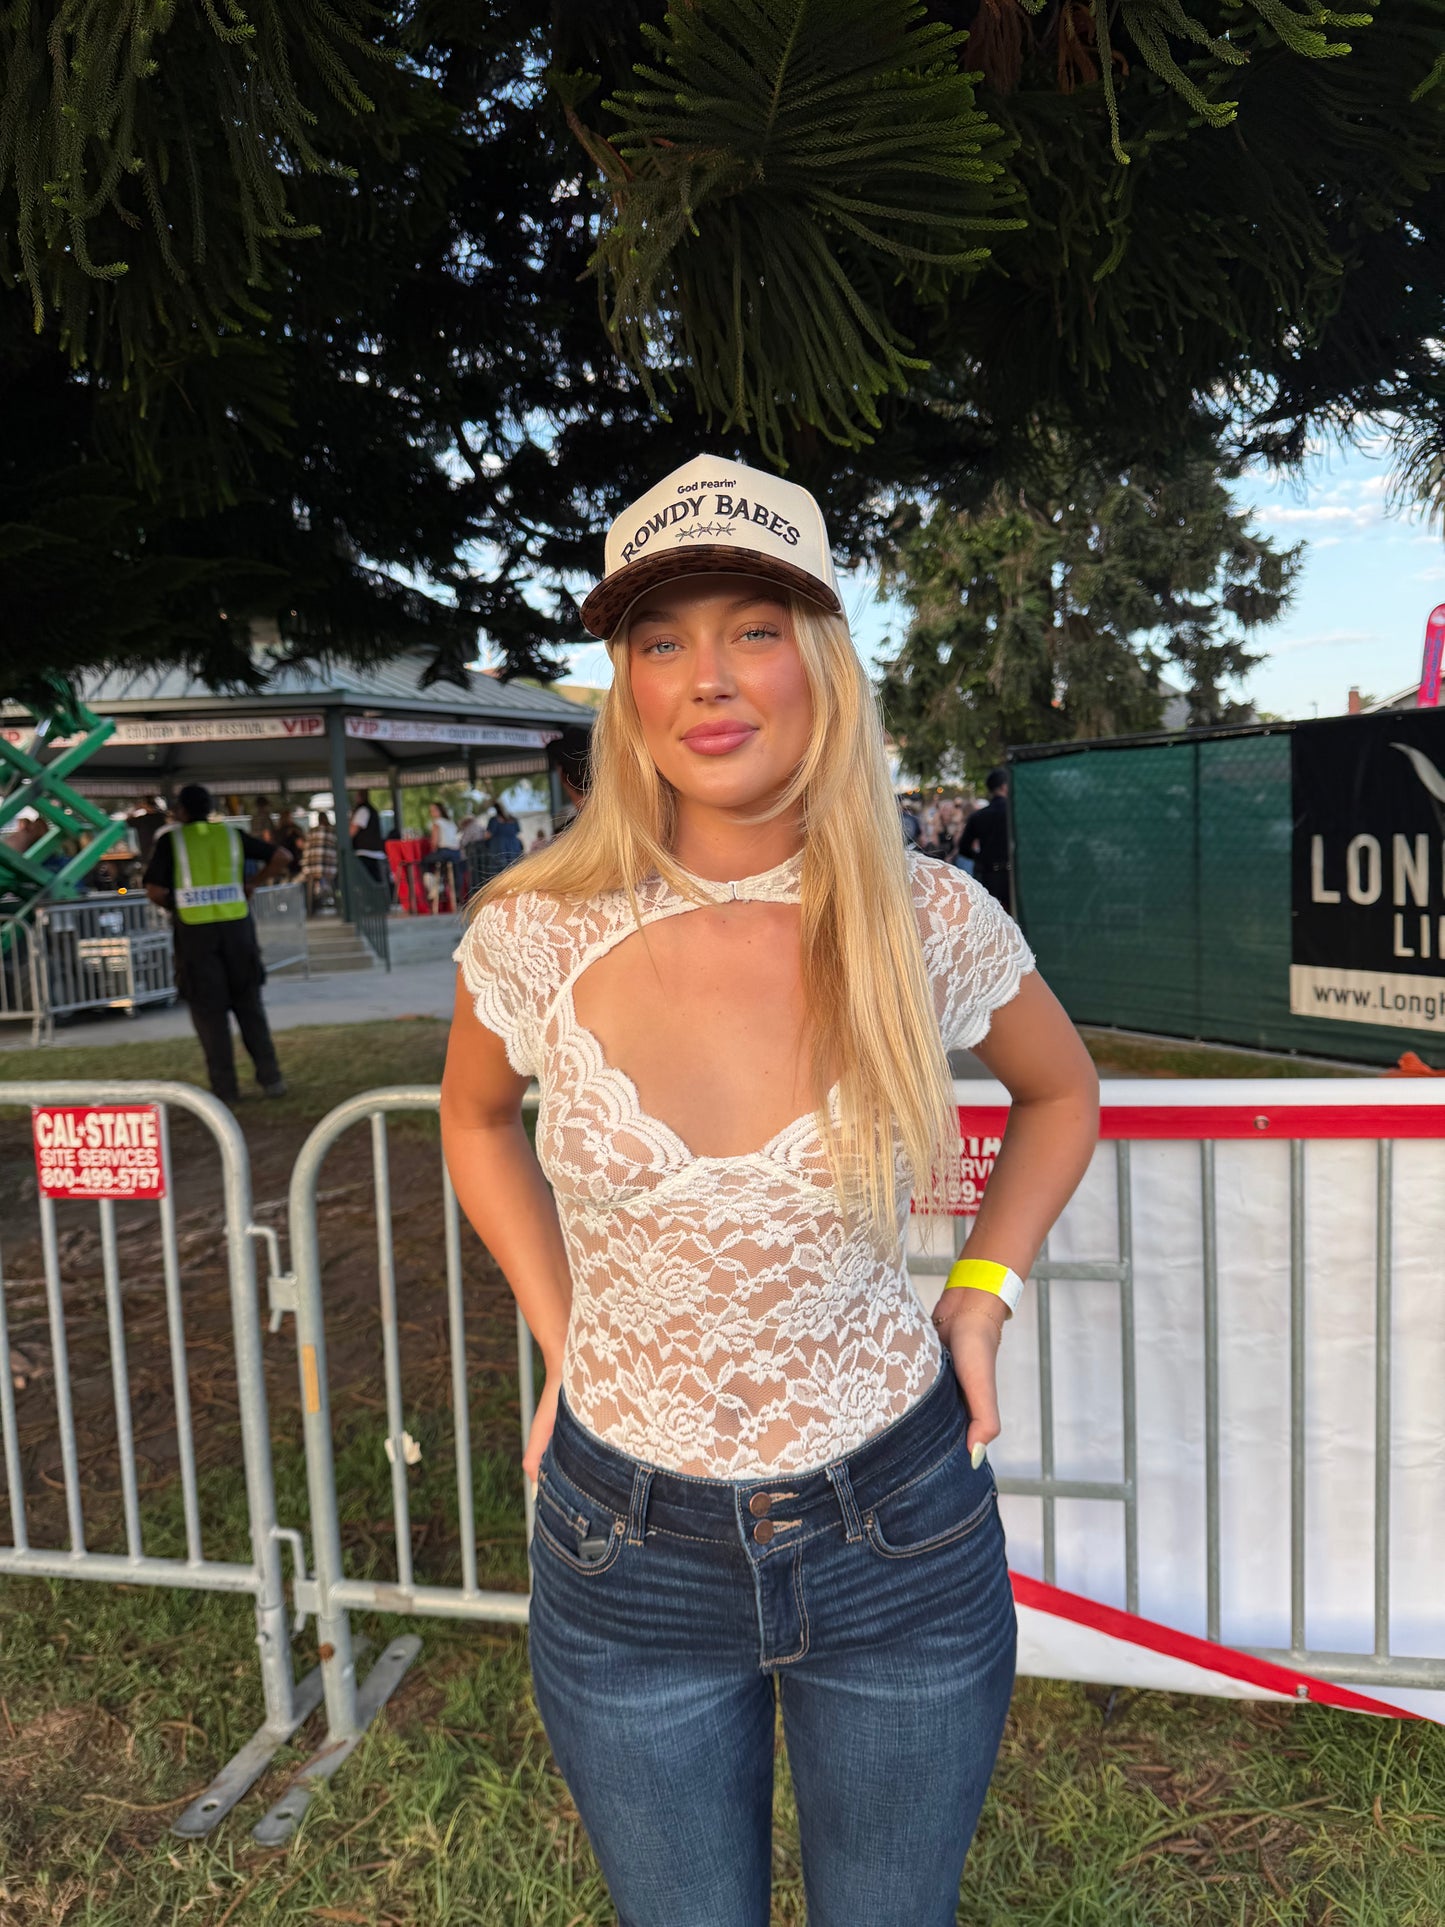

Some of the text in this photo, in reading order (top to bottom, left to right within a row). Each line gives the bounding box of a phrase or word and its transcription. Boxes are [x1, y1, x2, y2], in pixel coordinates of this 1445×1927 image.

[677, 481, 698, 494] God
[620, 494, 801, 564] ROWDY BABES
[281, 717, 320, 735] VIP
[350, 719, 378, 734] VIP
[1311, 832, 1445, 907] LON
[1394, 912, 1445, 960] LI
[40, 1147, 158, 1168] SITE SERVICES
